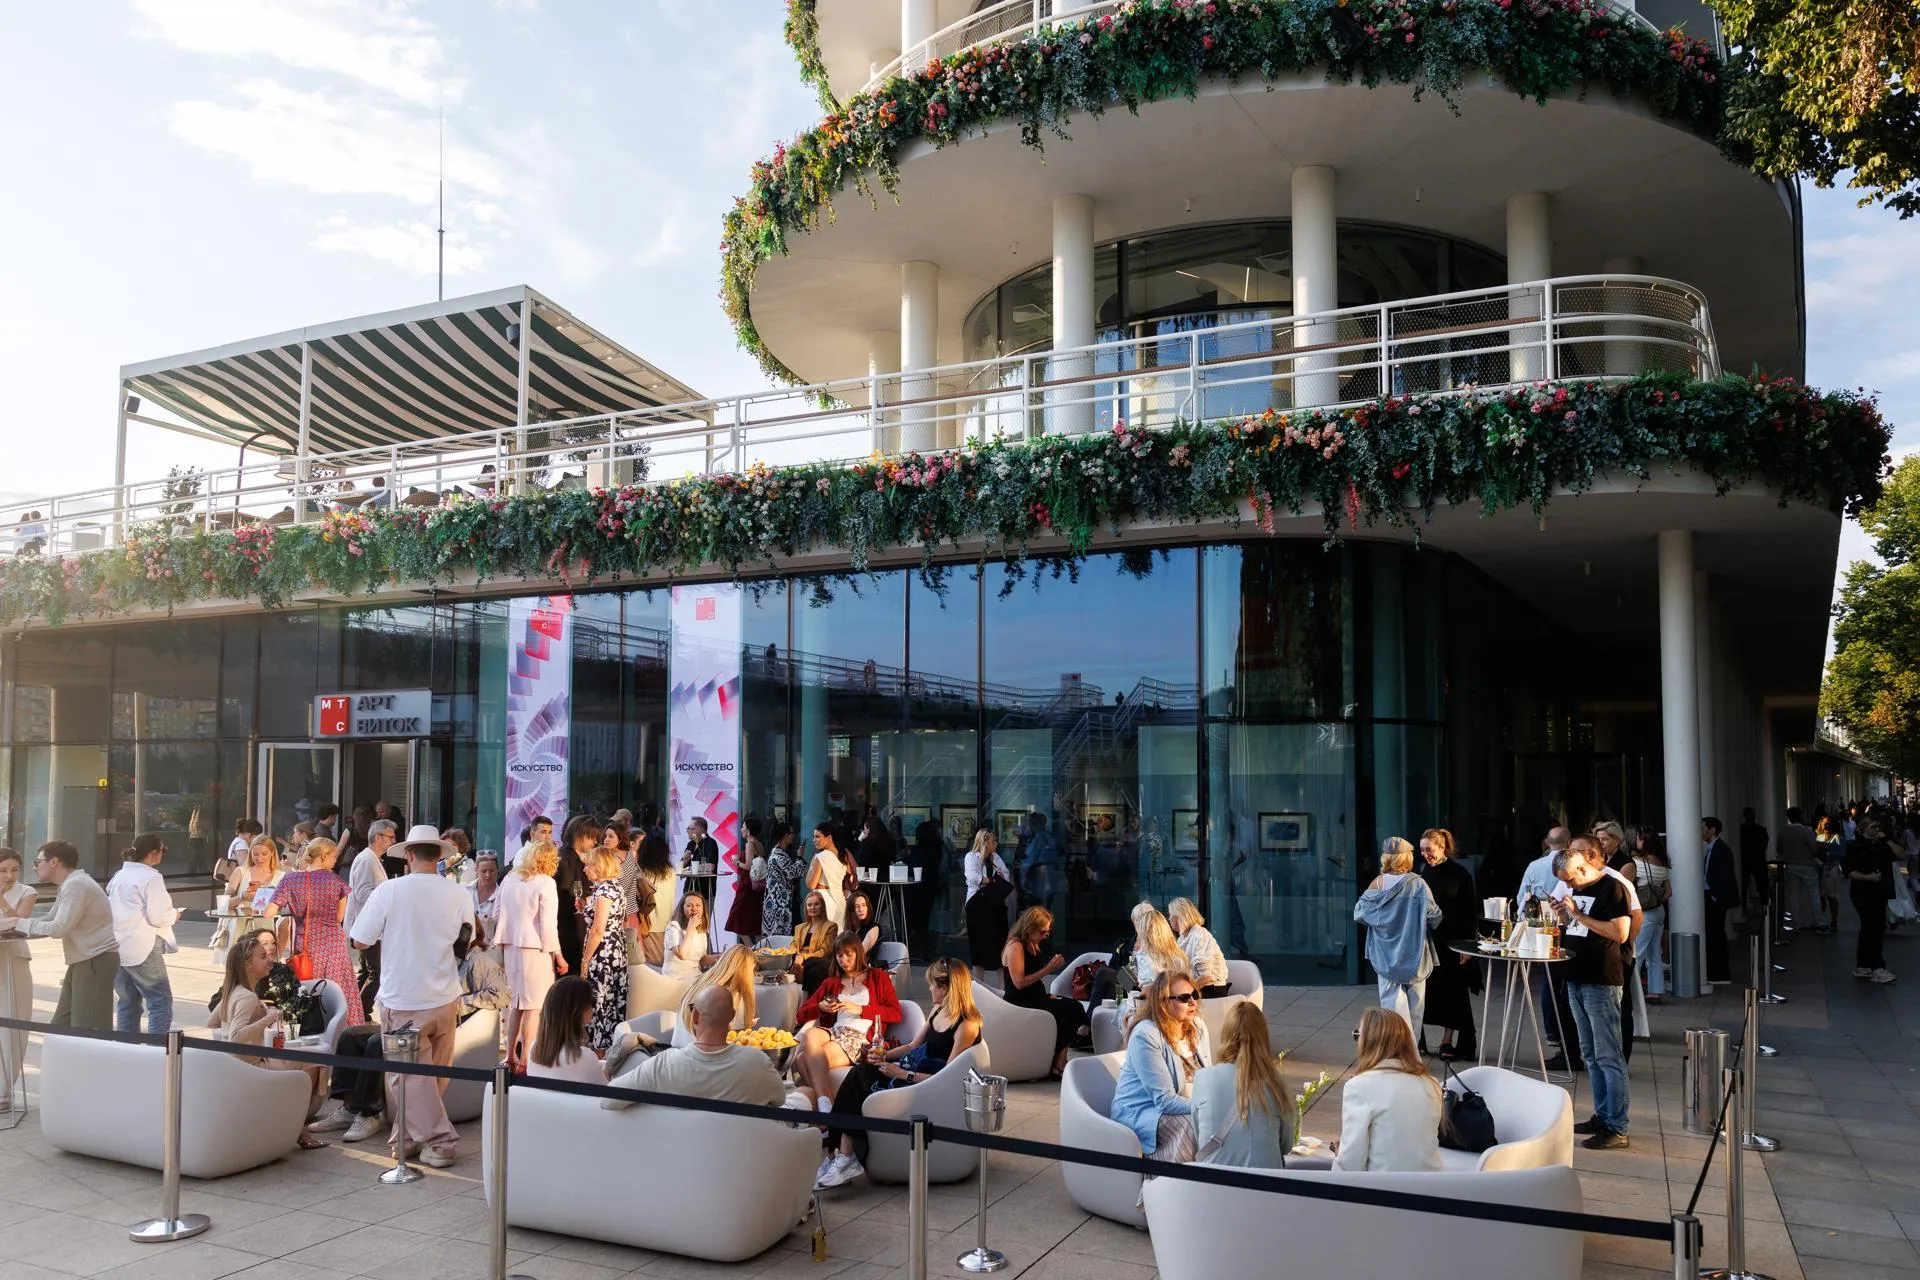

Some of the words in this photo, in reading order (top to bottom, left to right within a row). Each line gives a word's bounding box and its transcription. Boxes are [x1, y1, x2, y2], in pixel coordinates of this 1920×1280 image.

[357, 695, 395, 712] АРТ
[357, 717, 419, 733] ВИТОК
[510, 764, 563, 772] ИСКУССТВО
[675, 763, 734, 771] ИСКУССТВО
